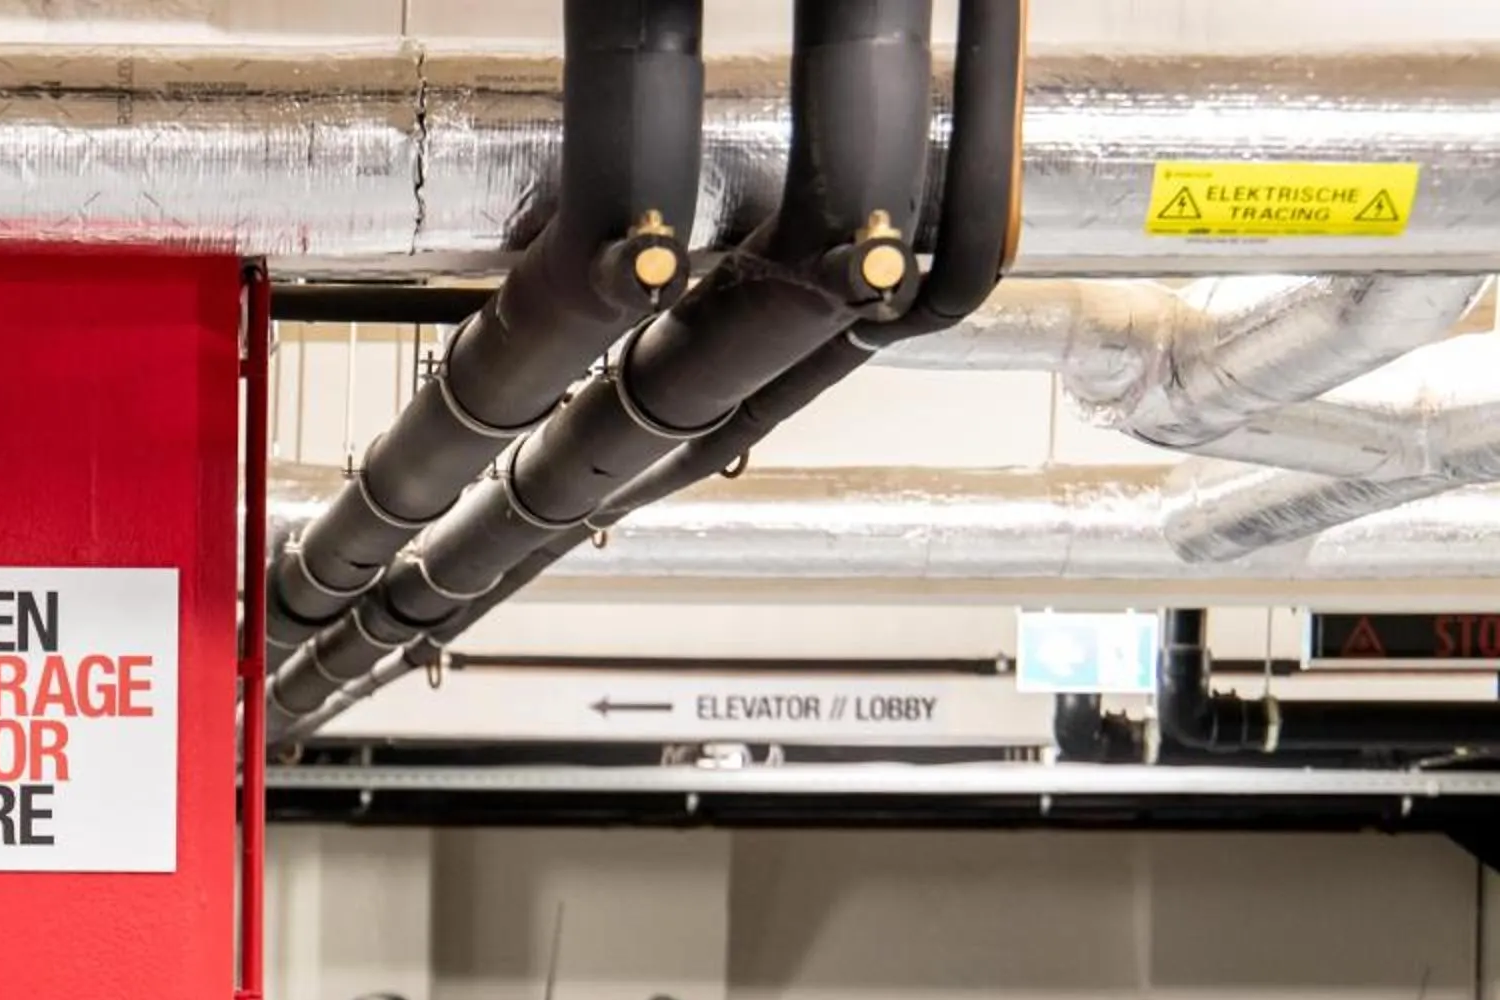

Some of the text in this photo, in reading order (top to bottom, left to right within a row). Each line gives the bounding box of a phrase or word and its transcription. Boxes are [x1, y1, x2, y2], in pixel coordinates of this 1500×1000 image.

[1206, 184, 1360, 204] ELEKTRISCHE
[1229, 206, 1331, 222] TRACING
[696, 695, 821, 721] ELEVATOR
[855, 695, 937, 722] LOBBY
